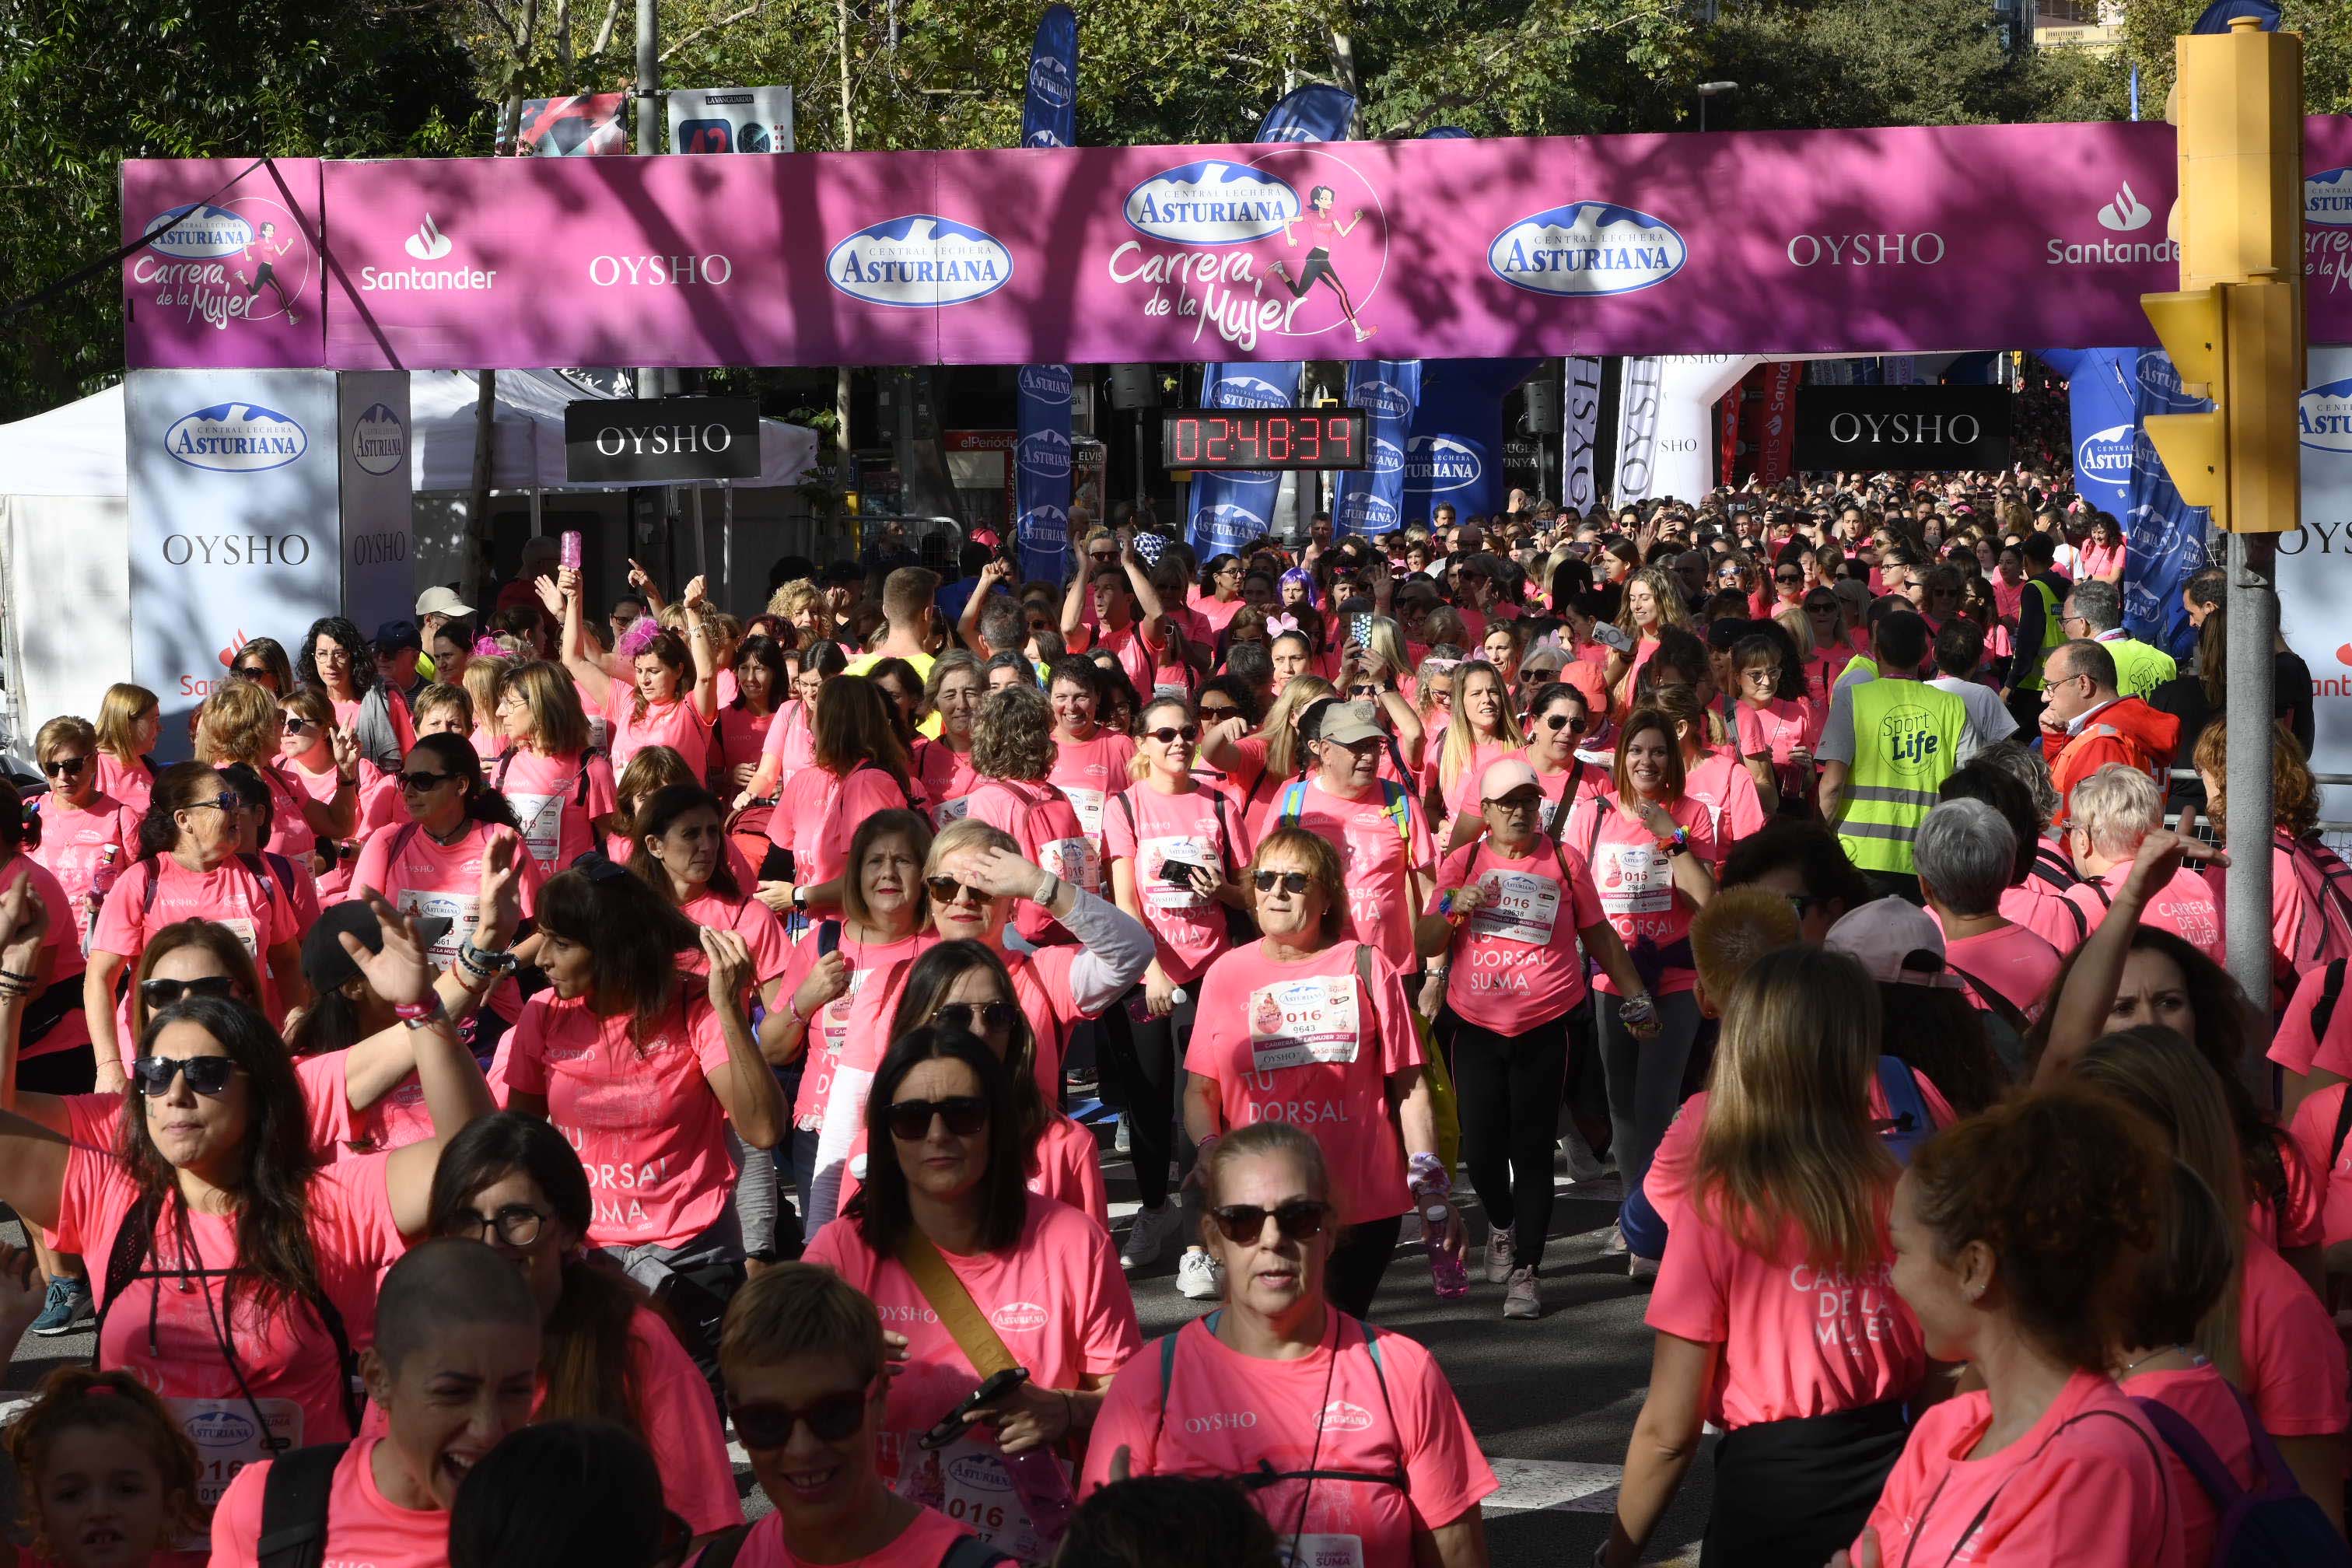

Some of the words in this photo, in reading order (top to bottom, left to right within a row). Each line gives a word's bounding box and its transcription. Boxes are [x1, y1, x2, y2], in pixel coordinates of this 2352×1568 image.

[1164, 189, 1220, 199] CENTRAL
[1225, 187, 1282, 198] LECHERA
[2304, 196, 2352, 212] STUR
[1136, 192, 1286, 225] ASTURIANA
[1534, 234, 1595, 244] CENTRAL
[1600, 233, 1664, 243] LECHERA
[1787, 232, 1945, 268] OYSHO
[870, 247, 929, 257] CENTRAL
[1108, 240, 1251, 285] Carrera
[1504, 238, 1671, 274] ASTURIANA
[2046, 237, 2180, 265] Santande
[133, 255, 226, 286] Carrera
[362, 266, 496, 291] Santander
[589, 254, 733, 285] OYSHO
[841, 249, 999, 284] ASTURIANA
[156, 290, 174, 307] de
[177, 289, 189, 306] la
[187, 280, 260, 331] Mujer
[1144, 294, 1170, 317] de
[1177, 285, 1195, 317] la
[1192, 278, 1308, 352] Mujer
[1770, 362, 1791, 412] Santa
[247, 425, 292, 434] LECHERA
[1570, 355, 1599, 507] OYSH
[1620, 355, 1660, 496] OYSH
[1829, 412, 1979, 445] OYSHO
[2300, 405, 2352, 435] ASTU
[177, 428, 297, 455] ASTURIANA
[356, 434, 402, 459] ASTURIANA
[597, 422, 732, 457] OYSHO
[1176, 418, 1348, 461] 02:48:39
[1503, 443, 1538, 454] UGES
[1657, 438, 1698, 453] SHO
[1078, 451, 1103, 462] ELVIS
[1367, 453, 1399, 467] RIANA
[1503, 457, 1538, 468] UNYA
[1405, 462, 1474, 479] TURIANA
[162, 534, 310, 565] OYSHO
[354, 530, 406, 566] OYSHO
[2277, 521, 2352, 555] OYS
[1883, 712, 1930, 737] Sport
[1892, 730, 1938, 765] Life
[1506, 880, 1537, 891] ASTURIANA
[1624, 870, 1648, 882] 016
[425, 905, 458, 915] ASTURIANA
[1503, 896, 1531, 909] 016
[1503, 908, 1525, 918] 29638
[2158, 899, 2217, 917] CARRERA
[2176, 915, 2196, 930] DE
[2195, 915, 2214, 929] LA
[436, 937, 450, 946] 661
[1472, 948, 1549, 968] DORSAL
[1471, 971, 1529, 990] SUMA
[1286, 1010, 1322, 1024] 016
[1293, 1024, 1316, 1034] 9643
[1264, 1038, 1295, 1049] CARRERA
[1303, 1035, 1313, 1044] LA
[1313, 1034, 1335, 1043] MUJER
[551, 1048, 597, 1062] OYSHO
[1262, 1052, 1297, 1064] OYSHO
[1240, 1070, 1274, 1091] TU
[1248, 1100, 1349, 1125] DORSAL
[582, 1157, 670, 1190] ORSAL
[590, 1199, 649, 1224] MA
[878, 1305, 940, 1325] OYSHO
[995, 1312, 1045, 1325] ASTURIANA
[1185, 1410, 1258, 1434] OYSHO
[954, 1462, 1010, 1487] ASTURIAN
[948, 1497, 1005, 1528] 016
[976, 1531, 994, 1543] 17
[1315, 1557, 1351, 1566] SUMA
